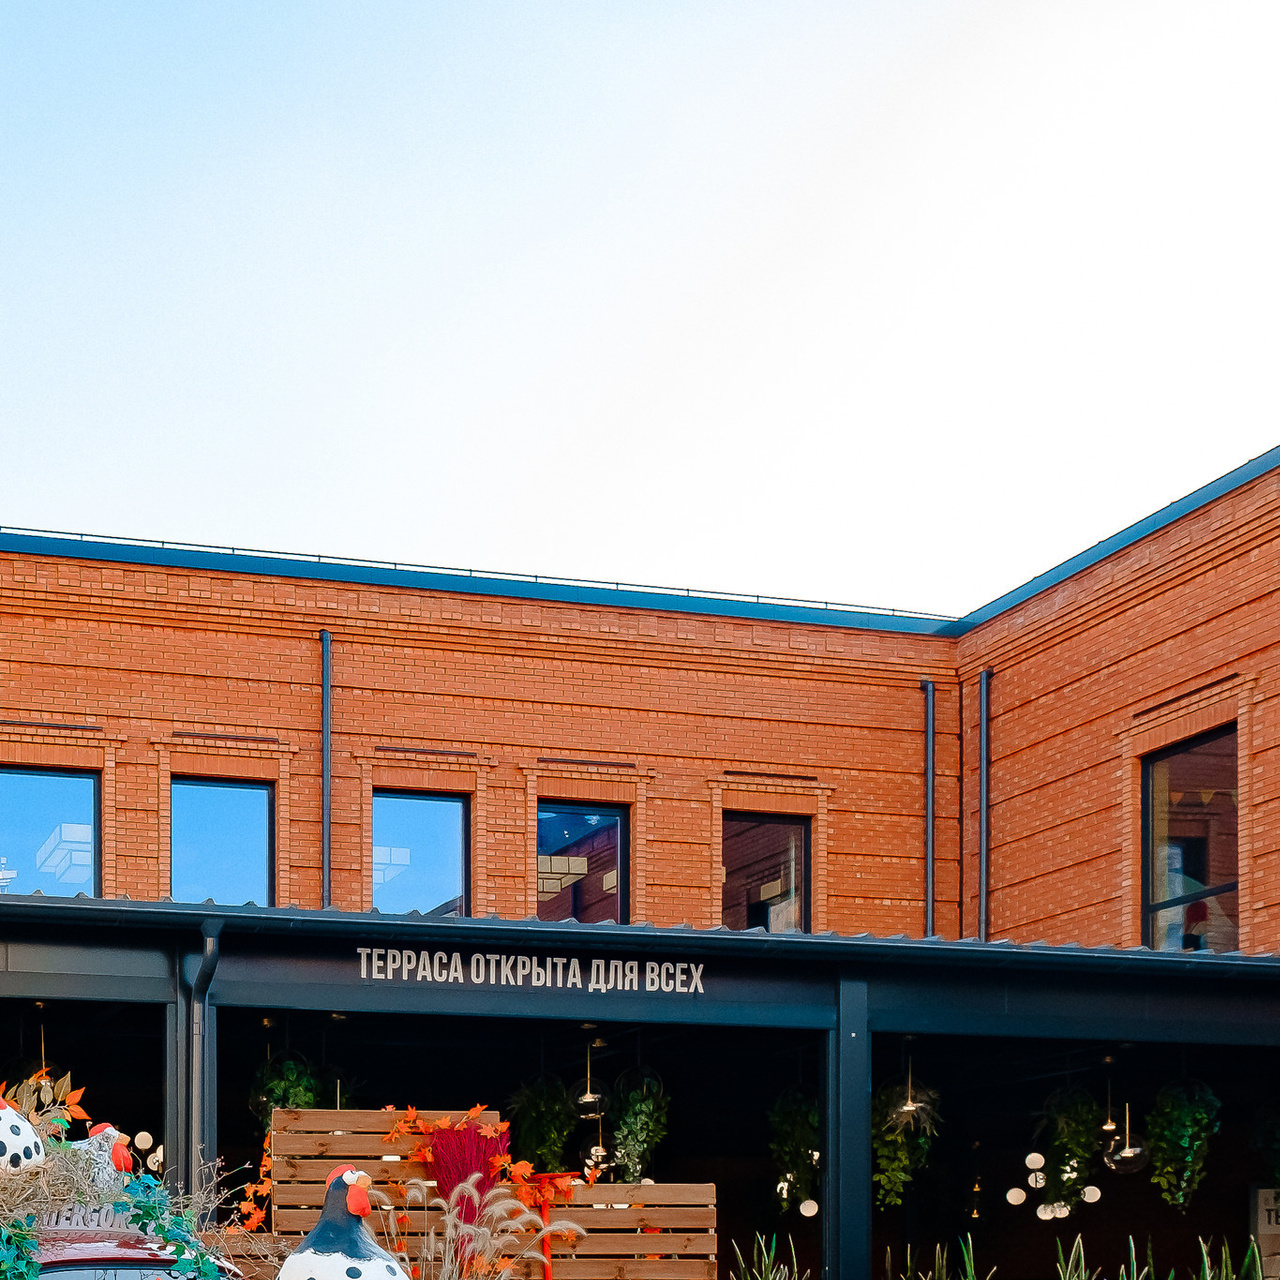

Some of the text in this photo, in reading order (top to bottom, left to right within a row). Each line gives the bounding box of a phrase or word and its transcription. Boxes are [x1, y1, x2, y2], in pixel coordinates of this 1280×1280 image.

[357, 947, 705, 994] ТЕРРАСА ОТКРЫТА ДЛЯ ВСЕХ
